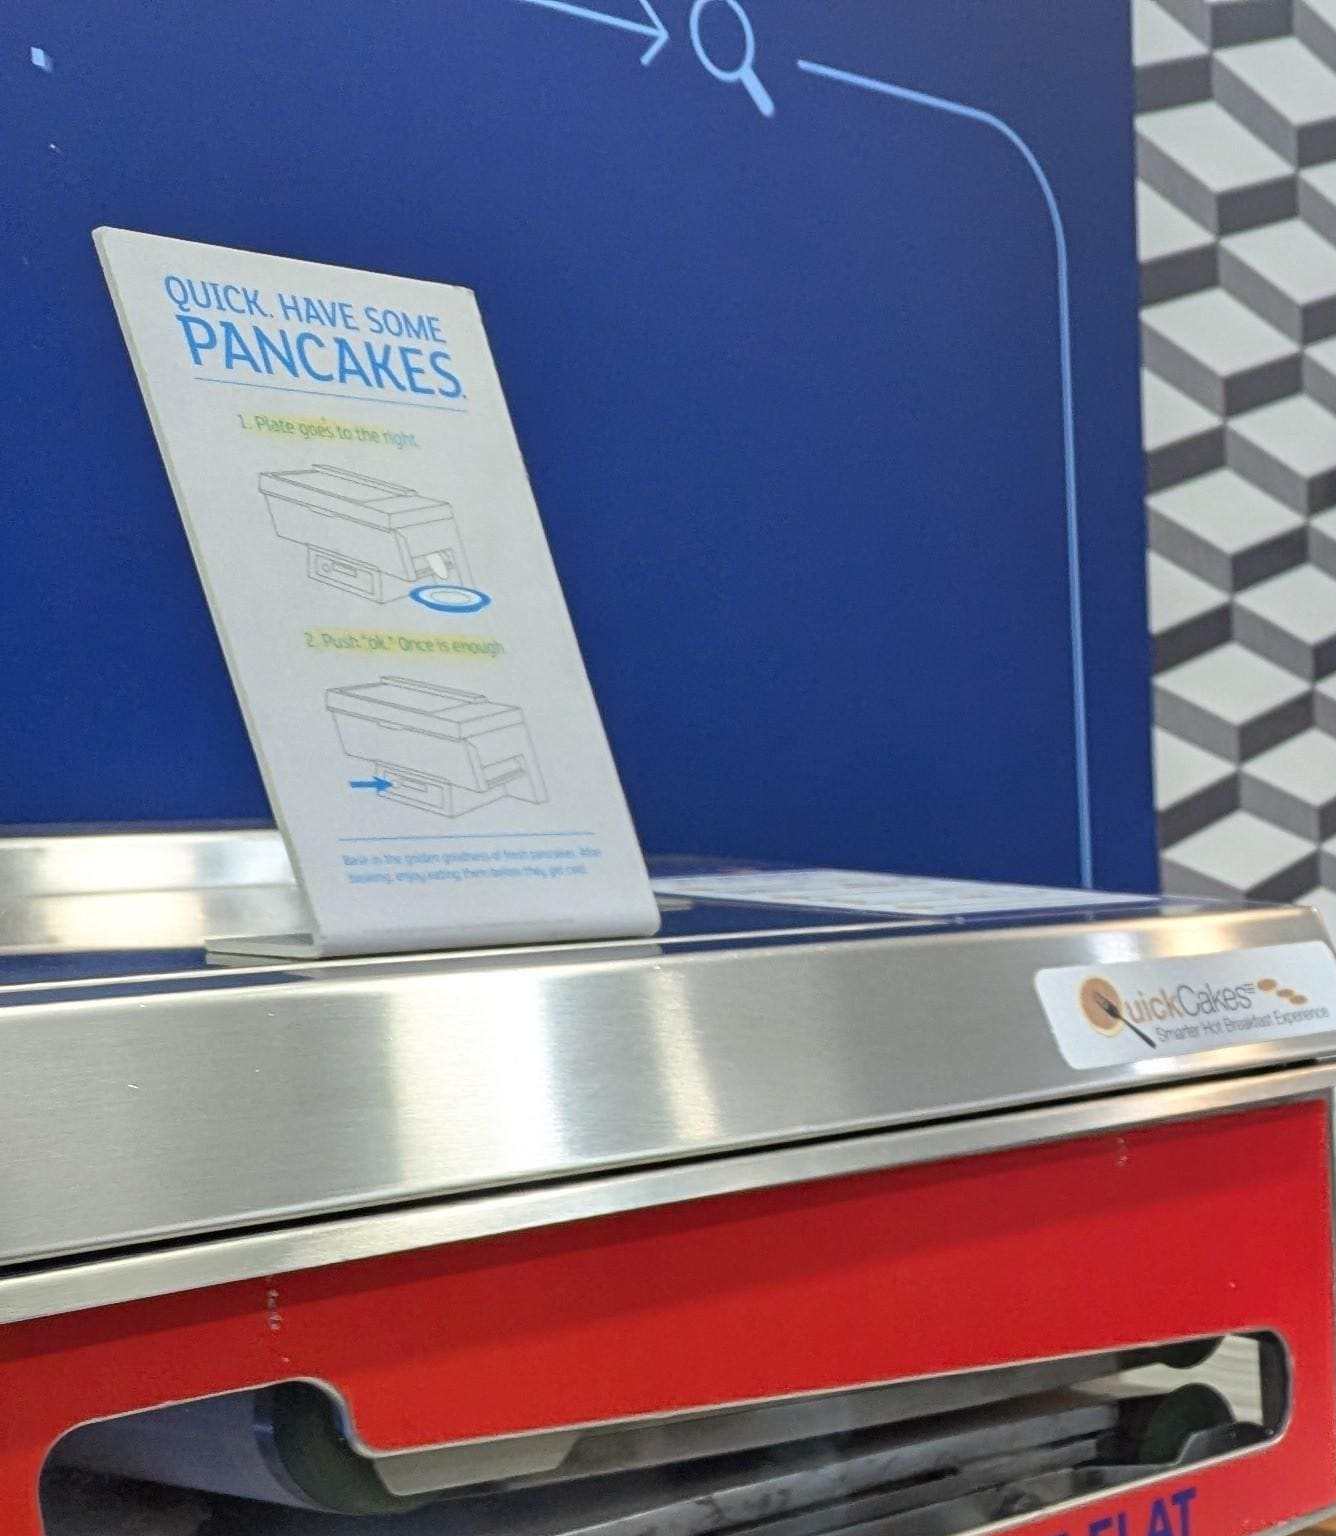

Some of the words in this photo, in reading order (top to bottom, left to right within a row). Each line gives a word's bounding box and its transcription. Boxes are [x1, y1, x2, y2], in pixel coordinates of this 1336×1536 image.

[164, 275, 273, 318] QUICK.
[278, 293, 360, 331] HAVE
[364, 307, 447, 344] SOME
[176, 314, 467, 399] PANCAKES.
[254, 415, 294, 435] Plate
[299, 421, 334, 439] goes
[336, 426, 352, 440] to
[355, 428, 379, 443] the
[320, 633, 359, 649] Push
[398, 636, 434, 651] Once
[437, 639, 449, 652] is
[1156, 1024, 1200, 1042] Smarter
[1203, 1021, 1222, 1036] Hot
[1224, 1014, 1271, 1033] Breakfast
[1272, 1006, 1330, 1027] Experience
